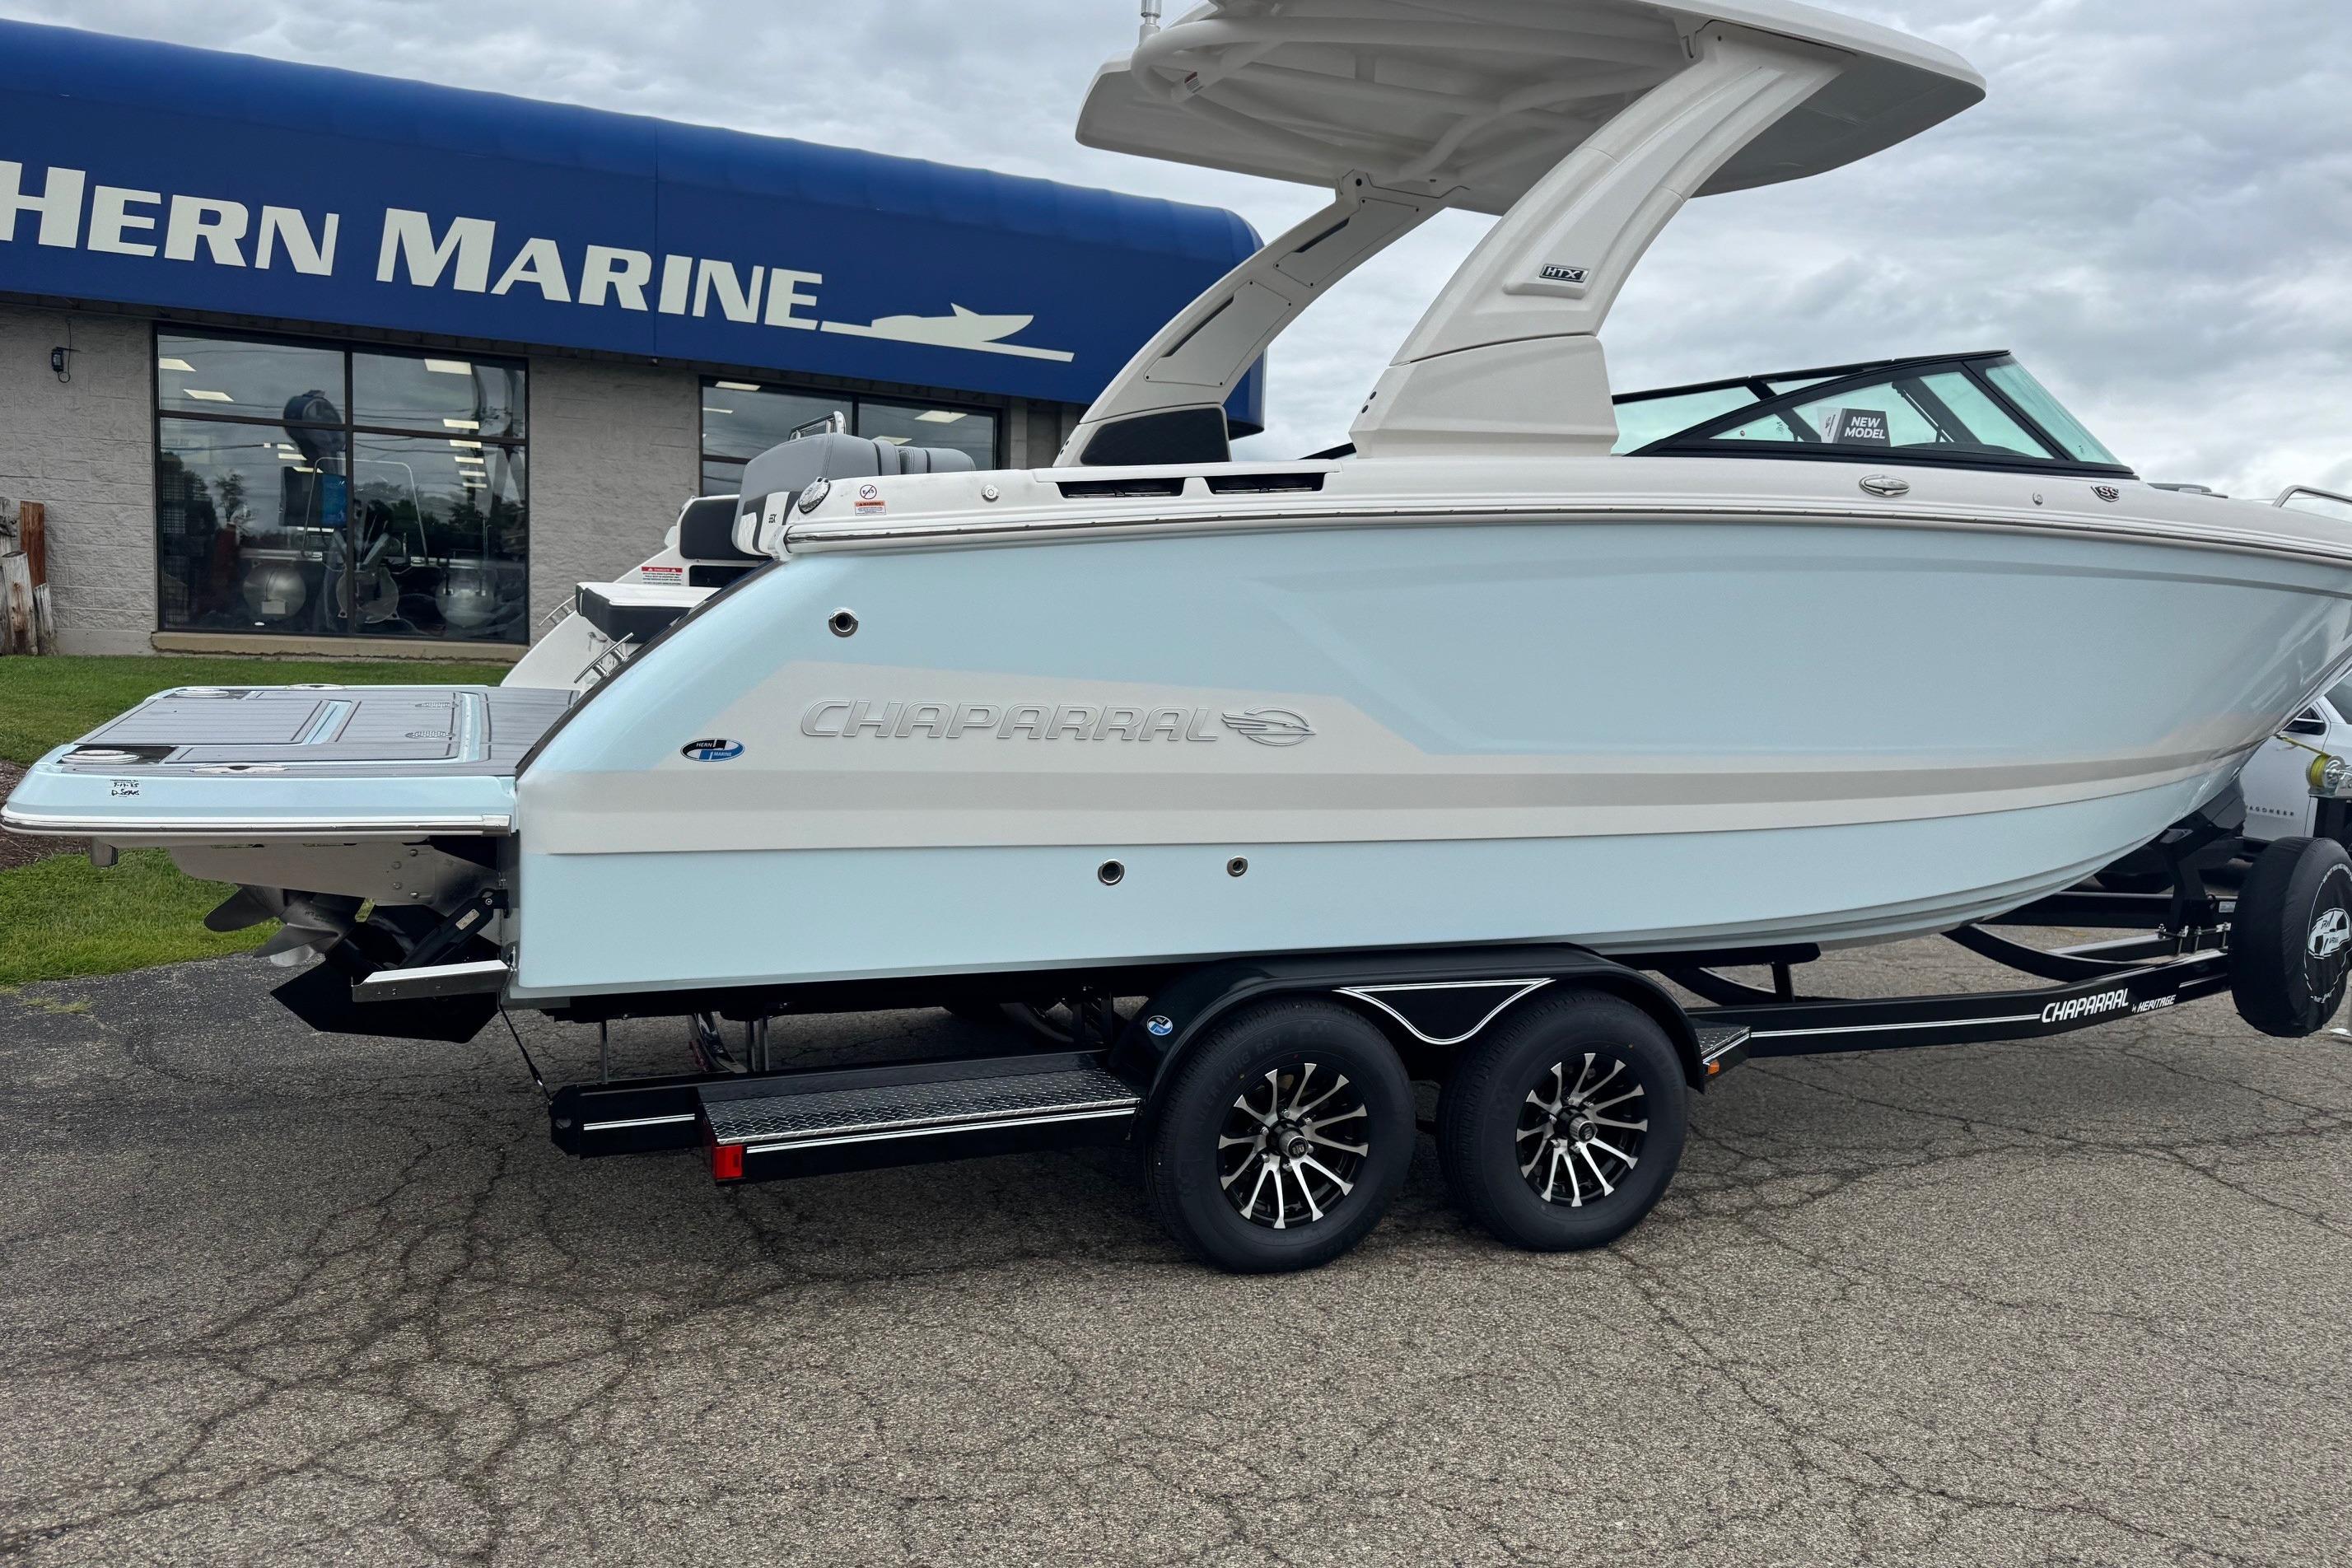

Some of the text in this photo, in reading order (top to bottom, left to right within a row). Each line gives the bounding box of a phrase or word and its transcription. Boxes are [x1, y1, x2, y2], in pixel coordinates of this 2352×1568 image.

[0, 161, 824, 331] HERN MARINE
[1546, 267, 1580, 279] HTX
[1845, 427, 1885, 439] MODEL
[1850, 416, 1881, 427] NEW
[800, 699, 1220, 742] CHAPARRAL
[2042, 988, 2177, 1023] CHAPARRAL HERITAGE
